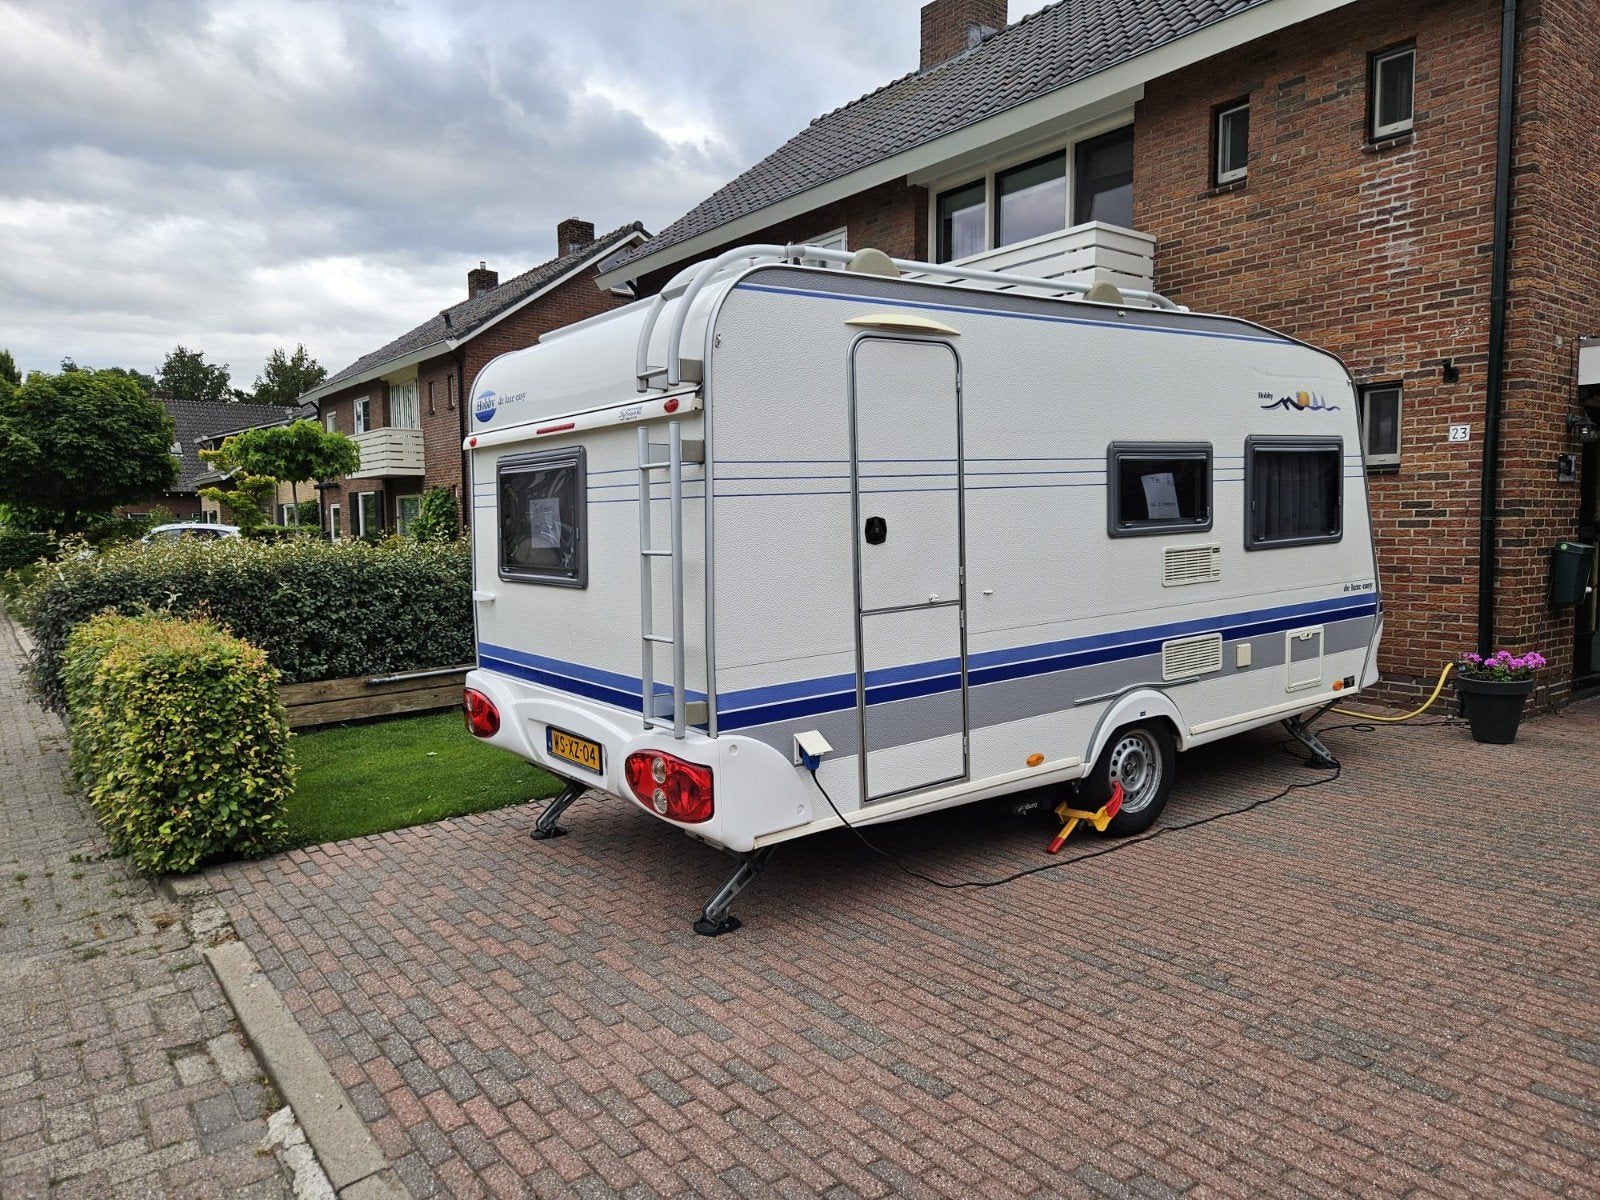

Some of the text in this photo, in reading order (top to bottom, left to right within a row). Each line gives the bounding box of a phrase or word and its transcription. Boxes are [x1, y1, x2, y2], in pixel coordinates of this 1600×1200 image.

[1258, 392, 1274, 400] Hobby
[476, 398, 495, 411] Hobby
[1452, 427, 1467, 440] 23
[1344, 584, 1350, 592] de
[553, 732, 596, 765] WS-XZ-04
